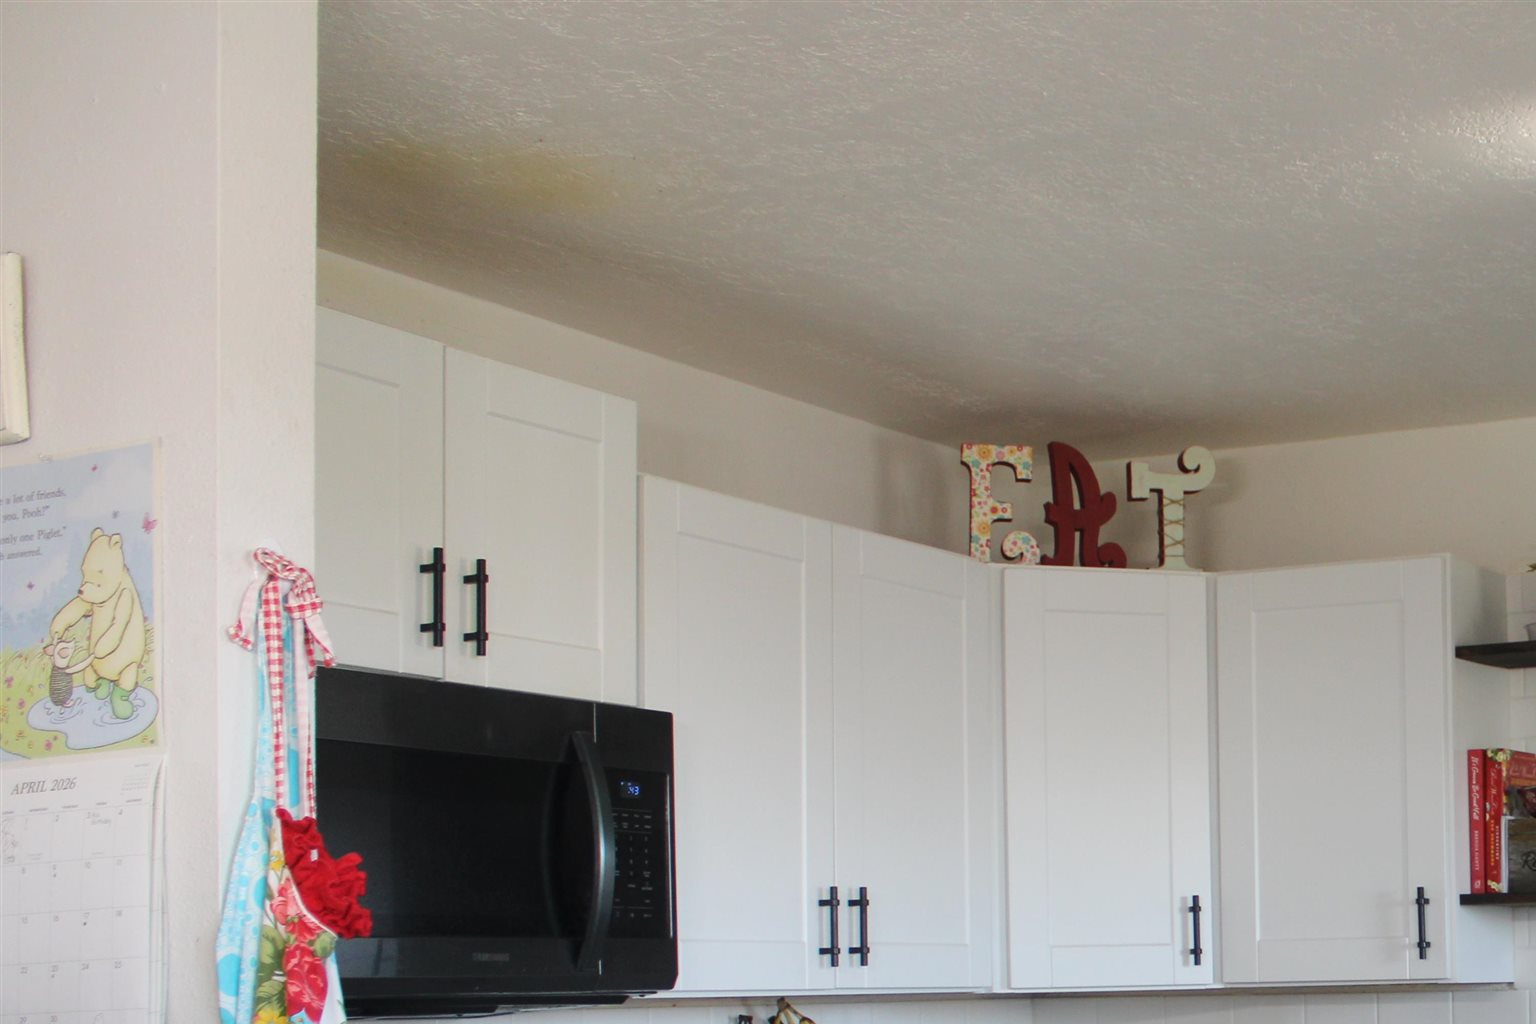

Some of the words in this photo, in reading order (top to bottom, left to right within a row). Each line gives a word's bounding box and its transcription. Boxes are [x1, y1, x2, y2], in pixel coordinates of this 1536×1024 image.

[960, 441, 1216, 570] EAT
[10, 781, 47, 795] APRIL
[50, 777, 77, 791] 2026
